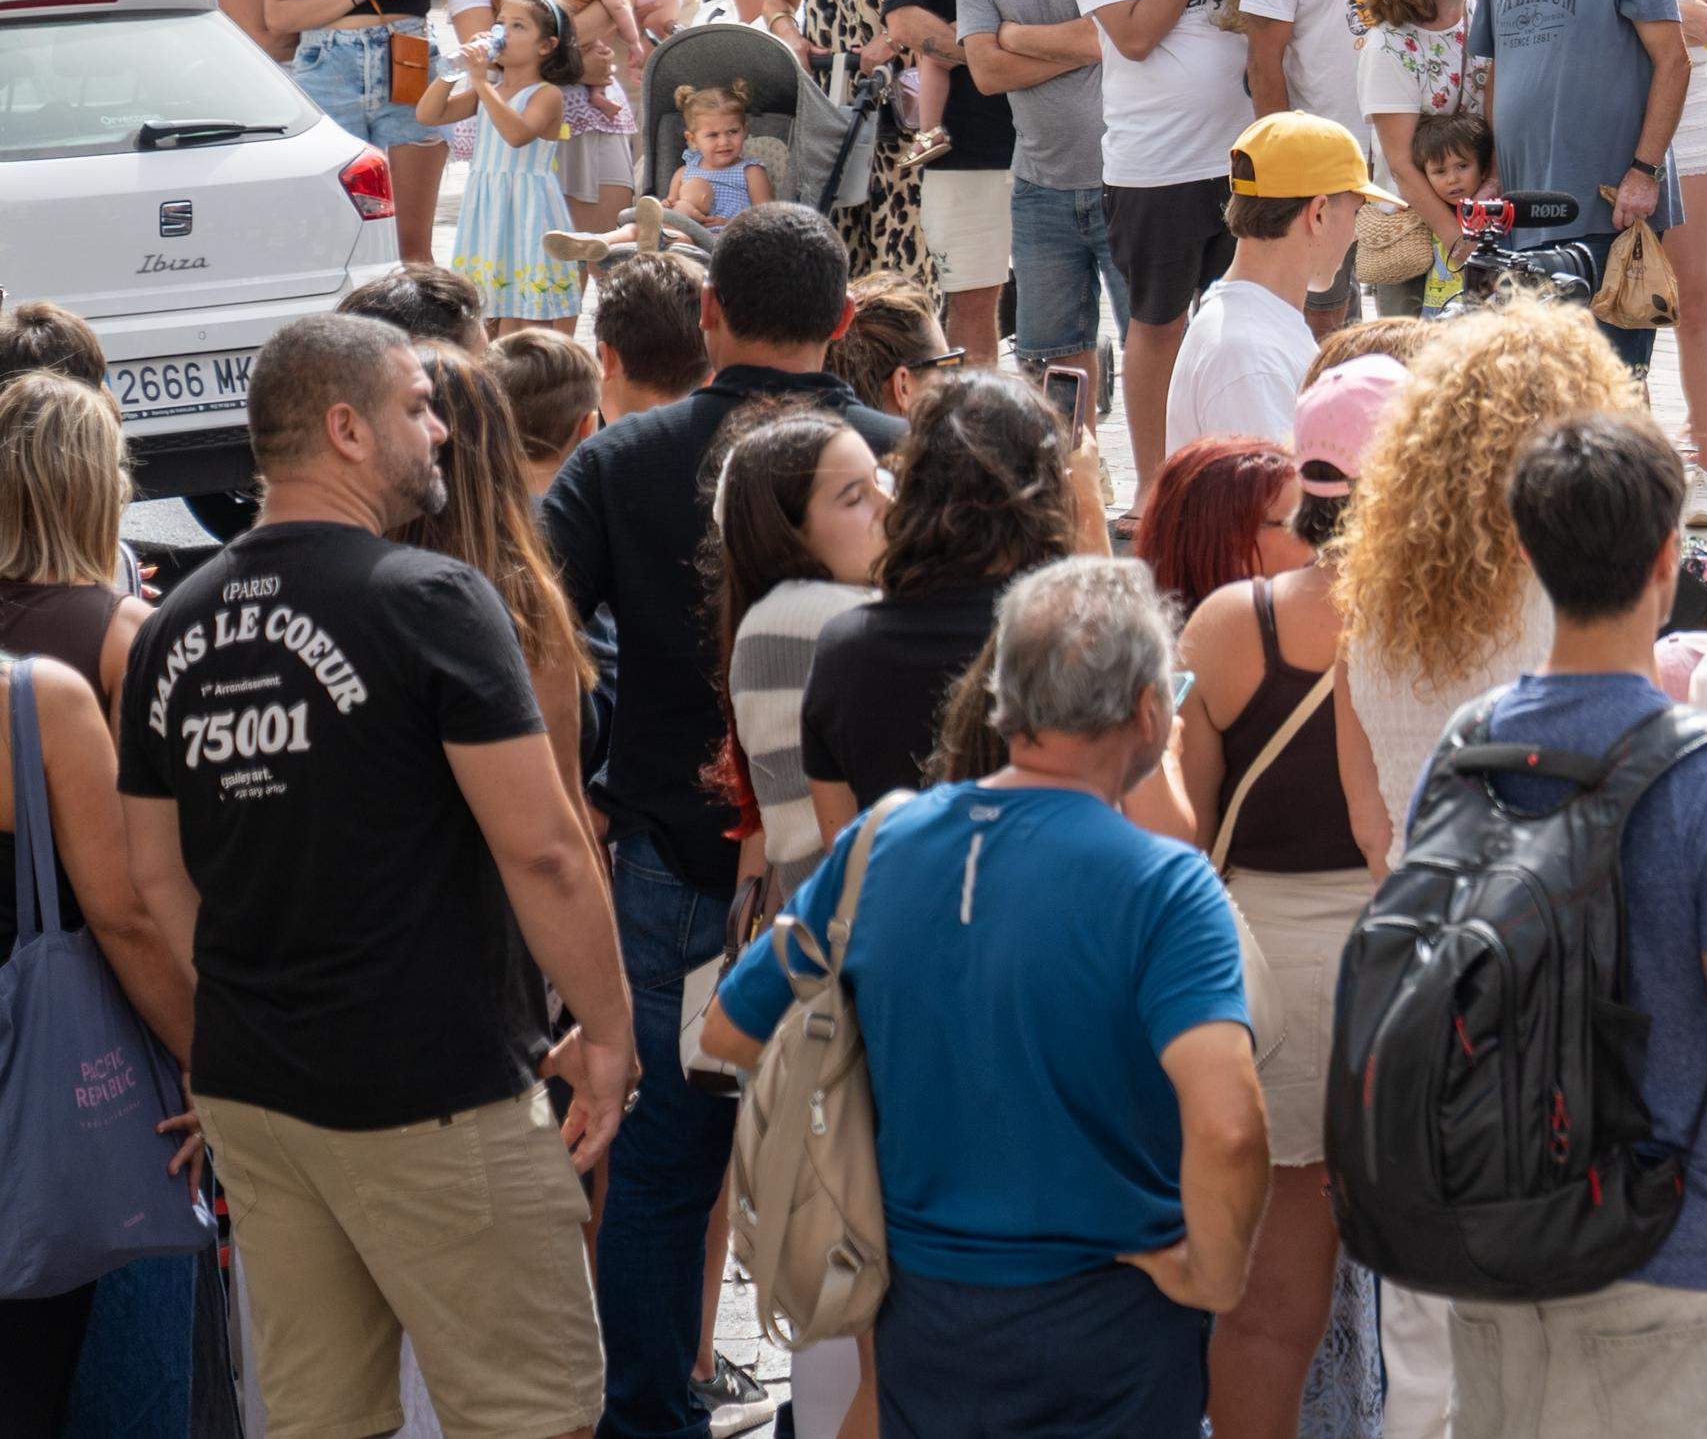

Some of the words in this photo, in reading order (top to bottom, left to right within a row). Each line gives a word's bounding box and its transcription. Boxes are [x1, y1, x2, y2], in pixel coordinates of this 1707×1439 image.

[1531, 204, 1568, 219] RØDE
[136, 254, 210, 274] Ibiza
[117, 362, 205, 405] 2666
[222, 576, 281, 604] (PARIS)
[149, 623, 208, 739] DANS
[213, 606, 261, 650] LE
[264, 604, 369, 715] COEUR
[181, 701, 311, 769] 75001
[80, 1047, 126, 1082] PACIFIC
[74, 1066, 136, 1109] REPUBLIC
